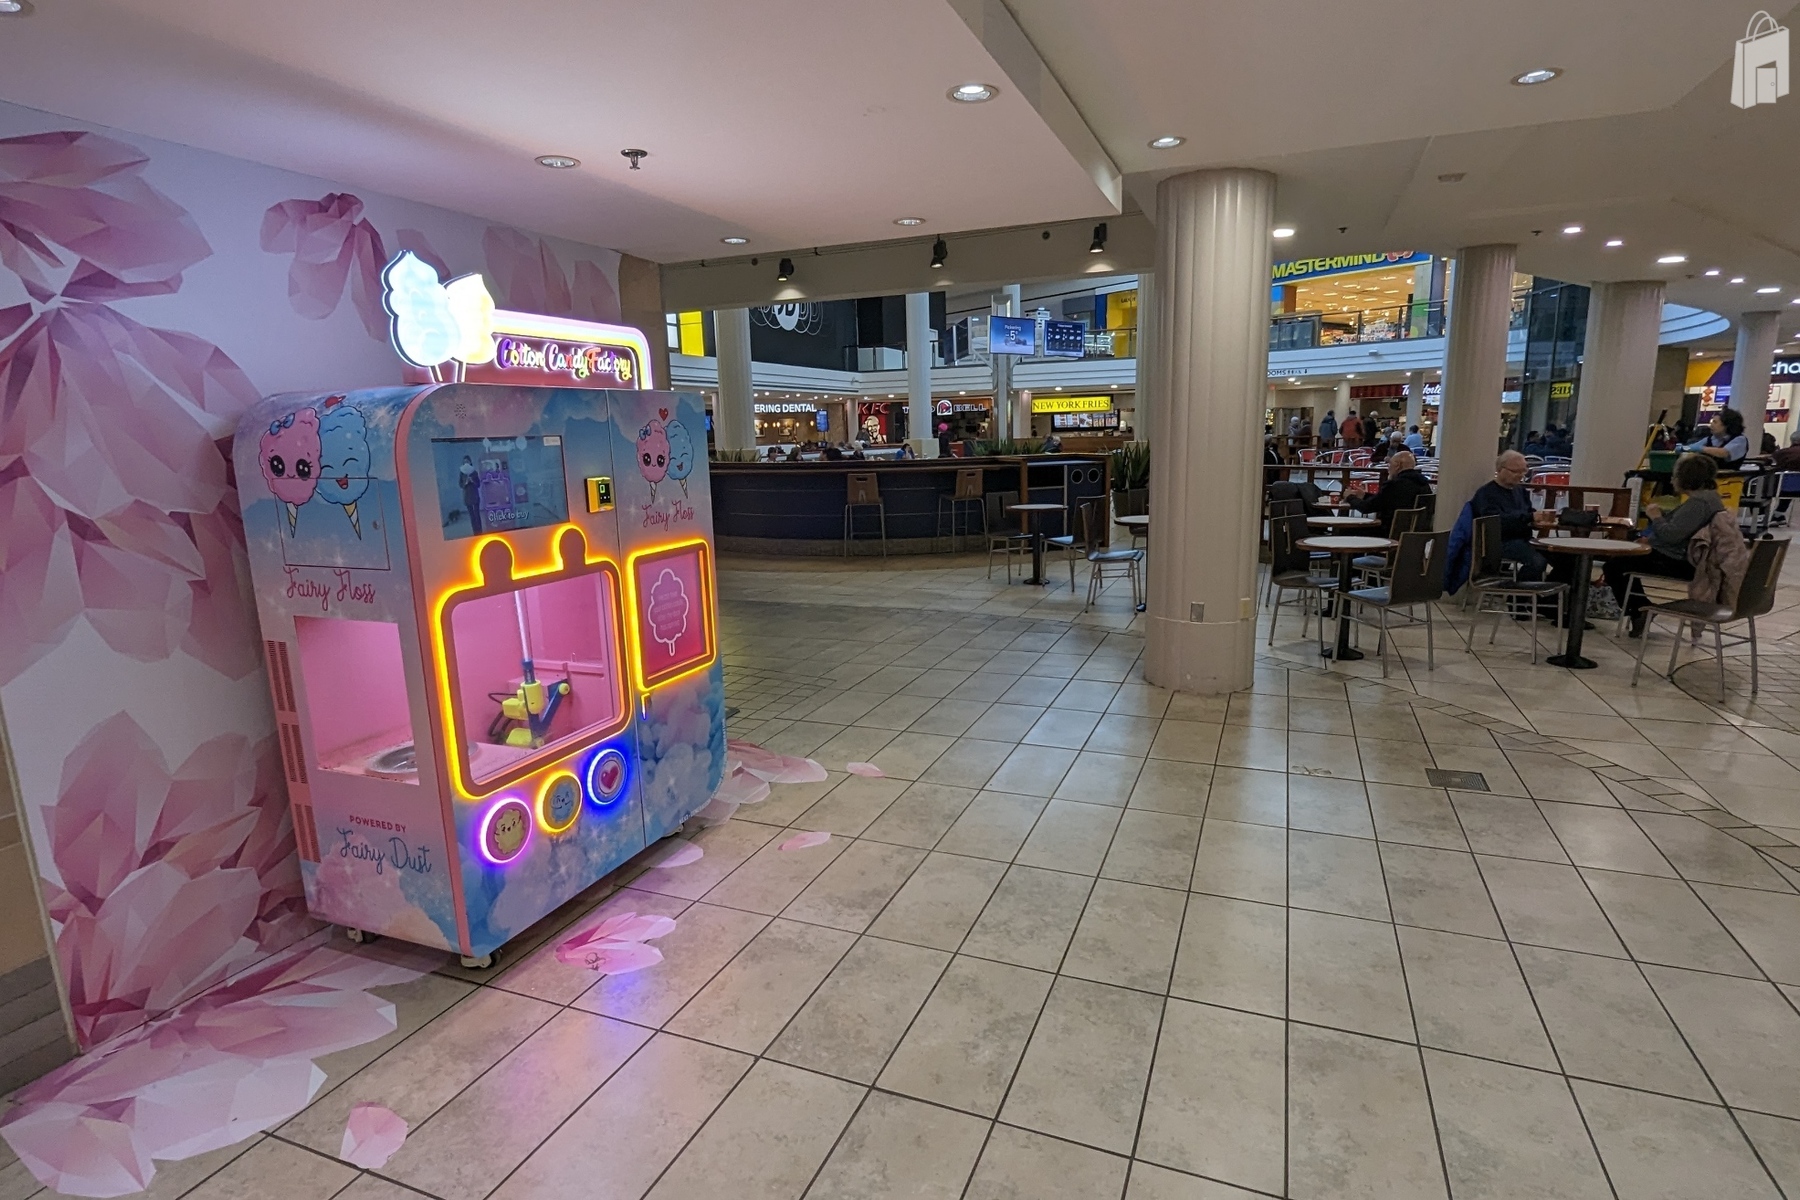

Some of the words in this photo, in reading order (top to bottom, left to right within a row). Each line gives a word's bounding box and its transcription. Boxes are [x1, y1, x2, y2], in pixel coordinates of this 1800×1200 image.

[1272, 253, 1385, 279] MASTERMIND
[498, 338, 545, 367] Cotton
[546, 343, 589, 379] Candy
[586, 346, 632, 381] Factory
[754, 404, 781, 413] ERING
[782, 403, 817, 413] DENTAL
[858, 402, 890, 414] KFC
[953, 403, 986, 412] BELL
[1033, 402, 1053, 411] NEW
[1056, 401, 1081, 410] YORK
[1082, 400, 1109, 408] FRIES
[508, 511, 515, 520] to
[516, 510, 530, 520] buy
[642, 504, 670, 531] Fairy
[672, 499, 694, 522] Floss
[283, 566, 330, 611] Fairy
[333, 569, 375, 604] Floss
[349, 815, 393, 831] POWERED
[395, 823, 406, 833] BY
[336, 827, 385, 875] Fairy
[388, 837, 432, 873] Dust
